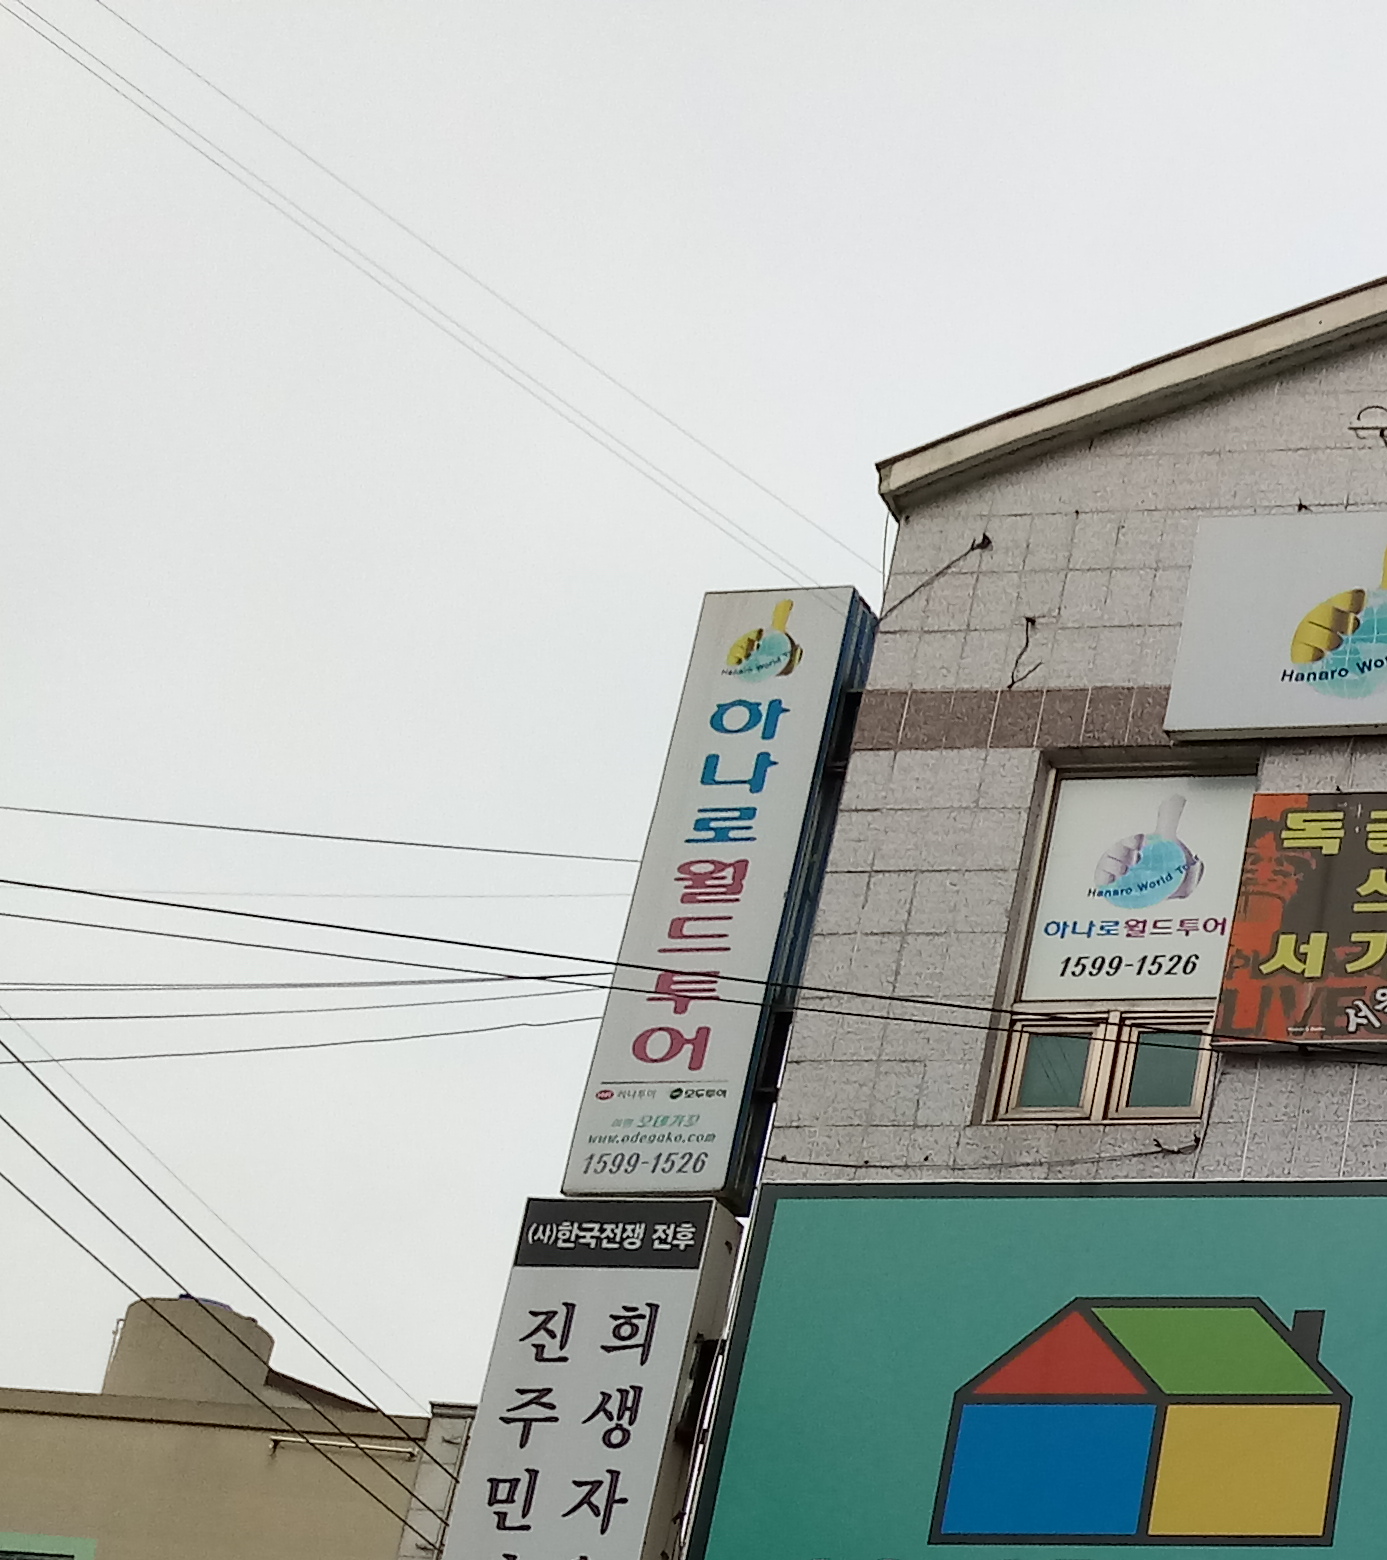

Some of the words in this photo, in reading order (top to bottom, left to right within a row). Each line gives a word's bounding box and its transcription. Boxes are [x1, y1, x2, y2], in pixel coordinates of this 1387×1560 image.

[1280, 667, 1350, 684] Hanaro
[1087, 886, 1133, 899] Hanaro
[1136, 873, 1174, 893] World
[1059, 953, 1200, 978] 1599-1526
[583, 1151, 709, 1175] 1599-1526
[527, 1219, 647, 1251] (사)한국전쟁
[651, 1222, 698, 1252] 전후
